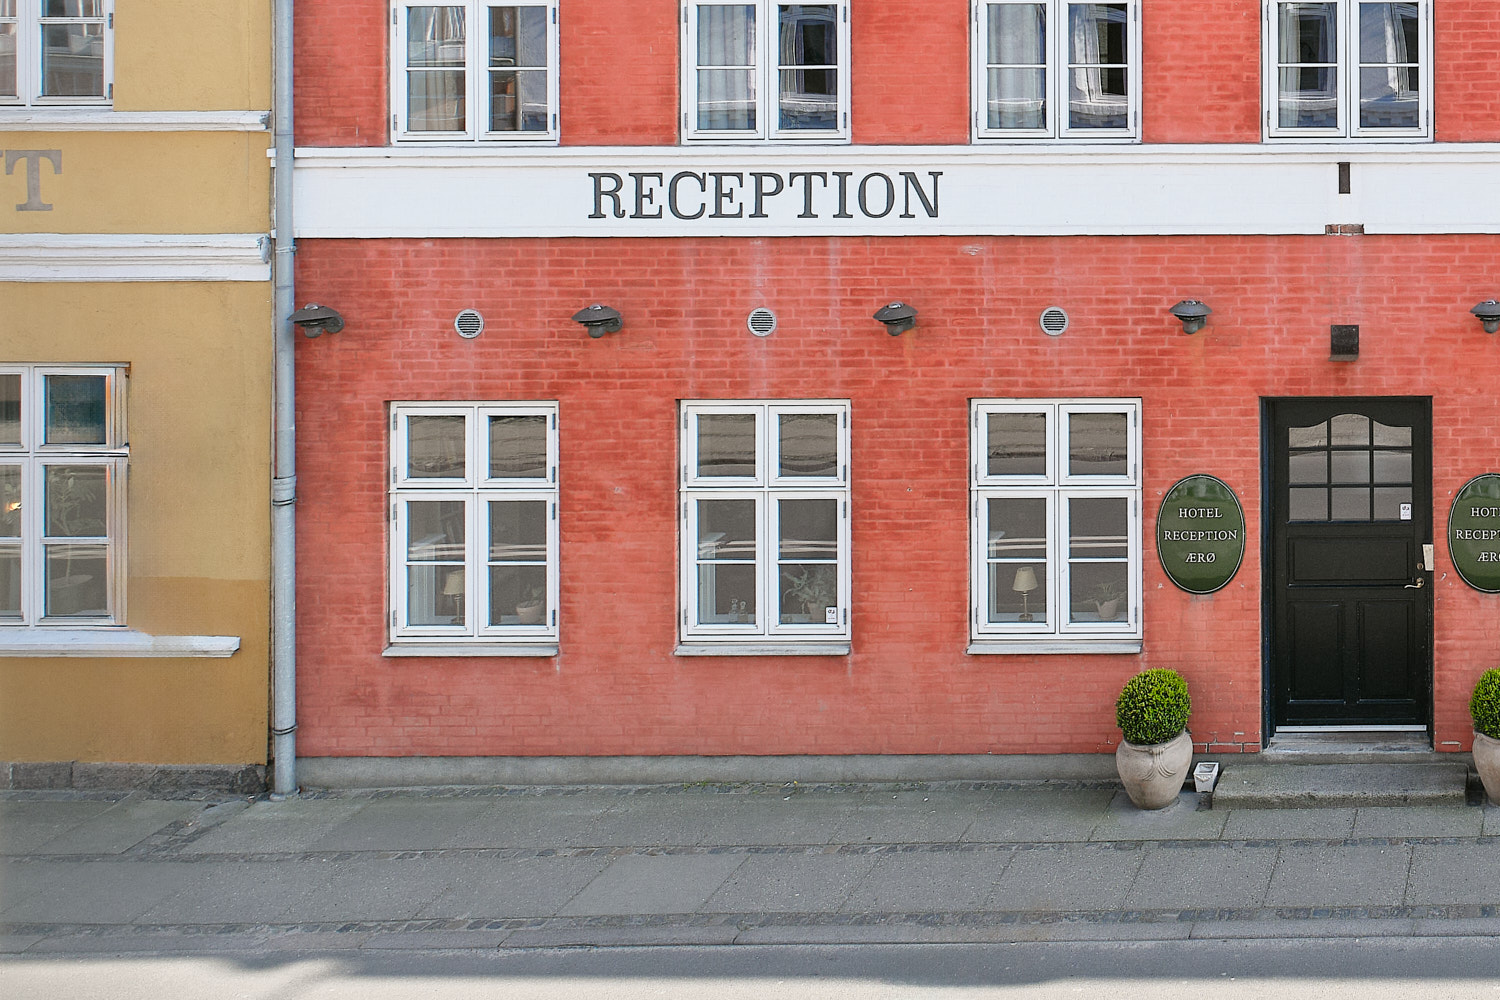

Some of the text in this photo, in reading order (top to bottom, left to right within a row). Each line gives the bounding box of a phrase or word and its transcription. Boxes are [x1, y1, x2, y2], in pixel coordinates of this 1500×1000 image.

[0, 149, 63, 211] T
[588, 170, 943, 220] RECEPTION
[1179, 507, 1223, 518] HOTEL
[1164, 529, 1238, 541] RECEPTION
[1185, 552, 1216, 563] ÆRØ
